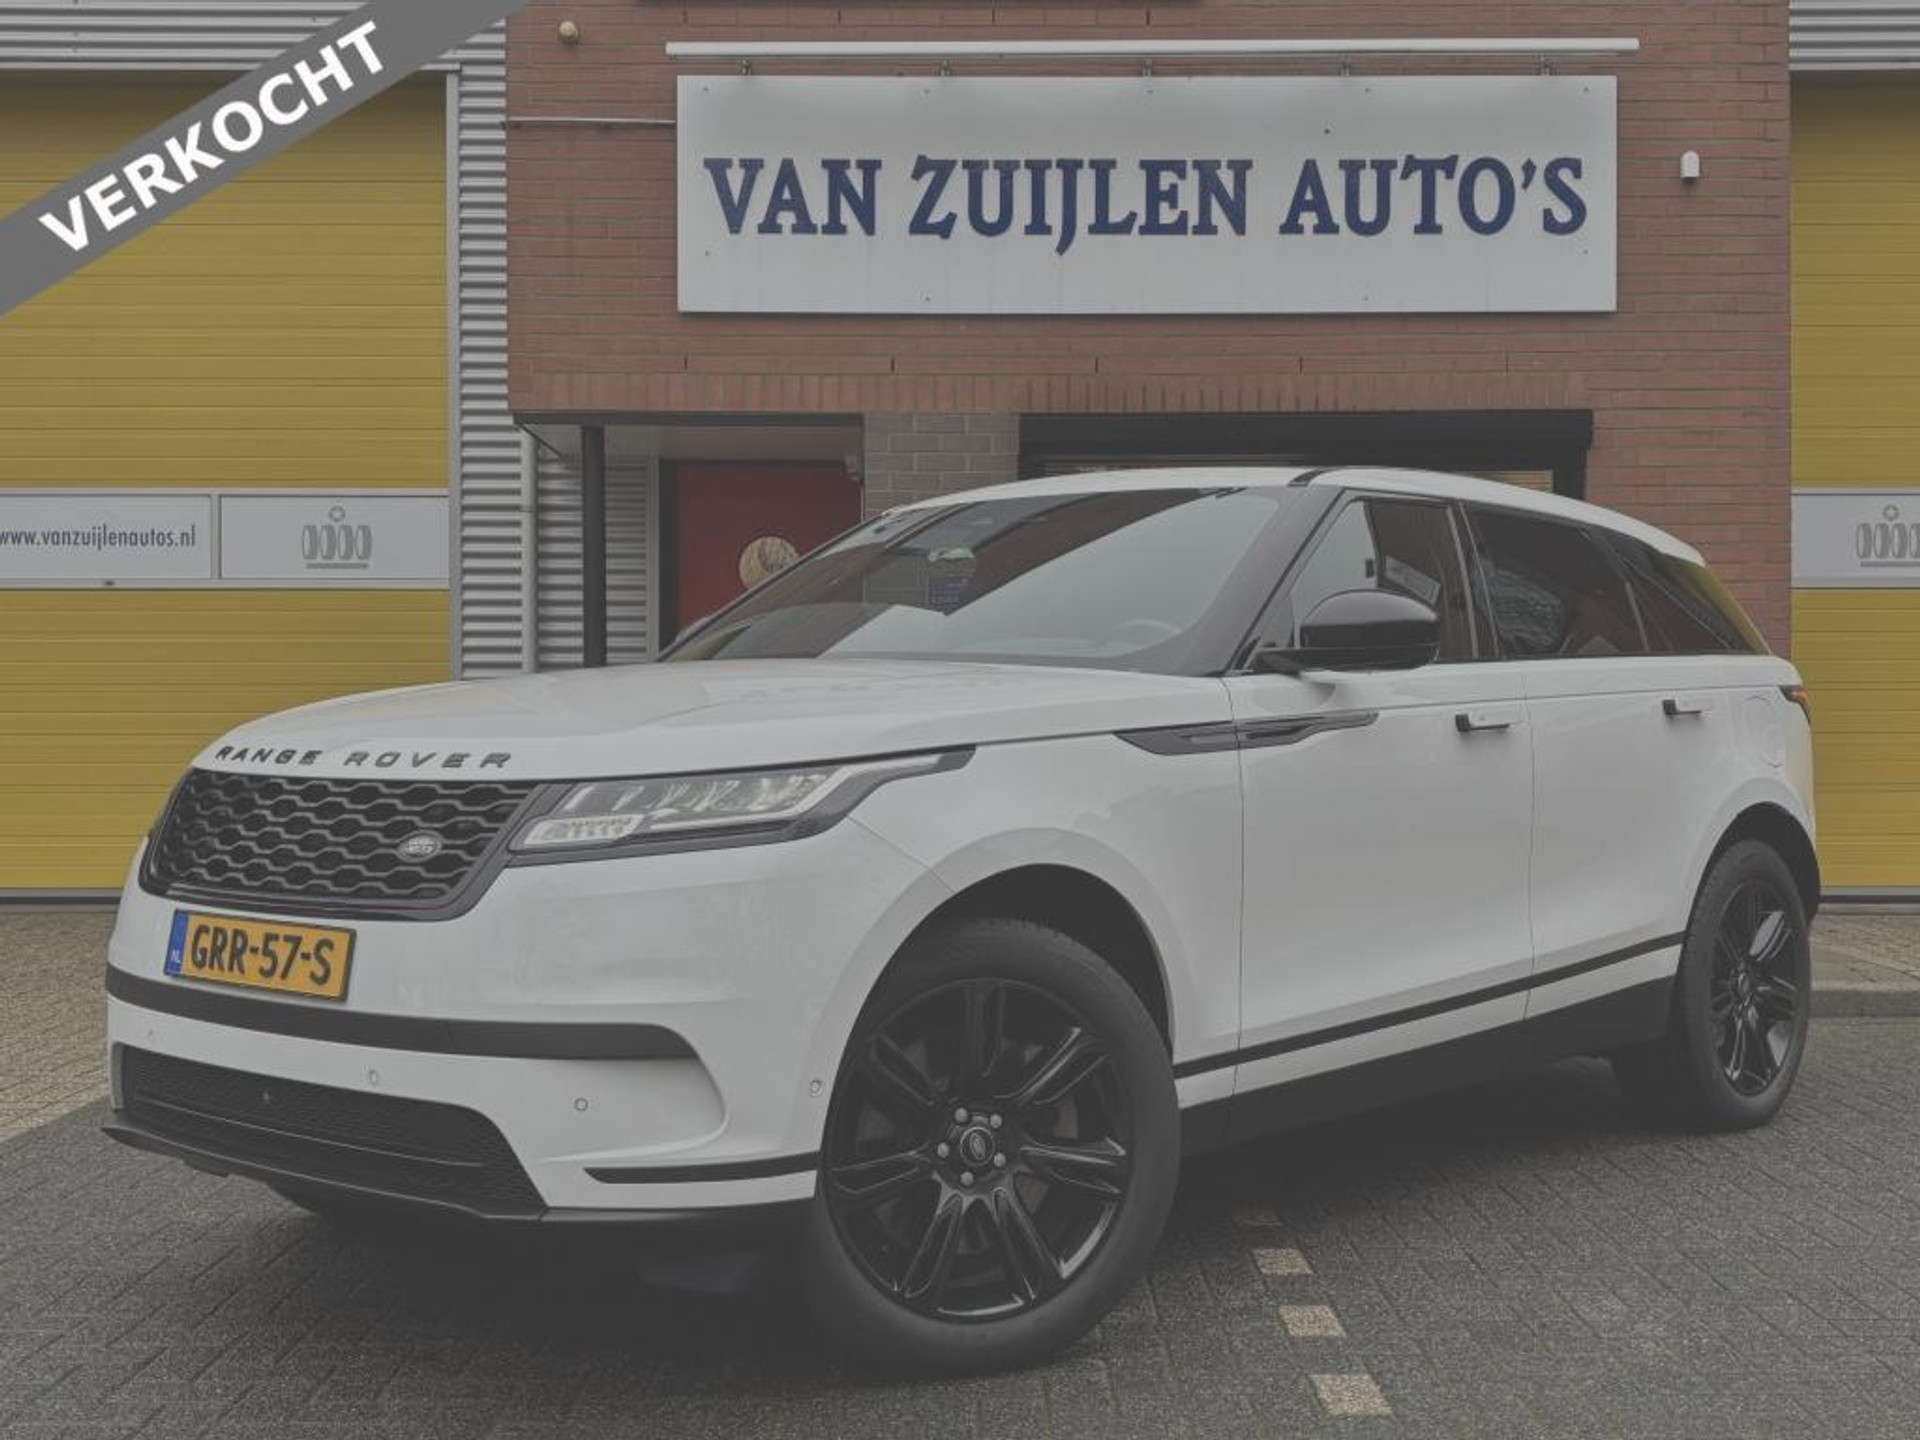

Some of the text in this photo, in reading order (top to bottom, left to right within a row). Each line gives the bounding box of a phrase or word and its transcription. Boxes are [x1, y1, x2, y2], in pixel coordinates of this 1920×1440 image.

[703, 153, 1588, 257] VAN ZUIJLEN AUTO'S
[0, 523, 196, 551] www.vanzuijlenautos.nl
[215, 746, 512, 768] RANGE ROVER
[171, 950, 181, 963] NL
[191, 924, 334, 986] GRR-57-S
